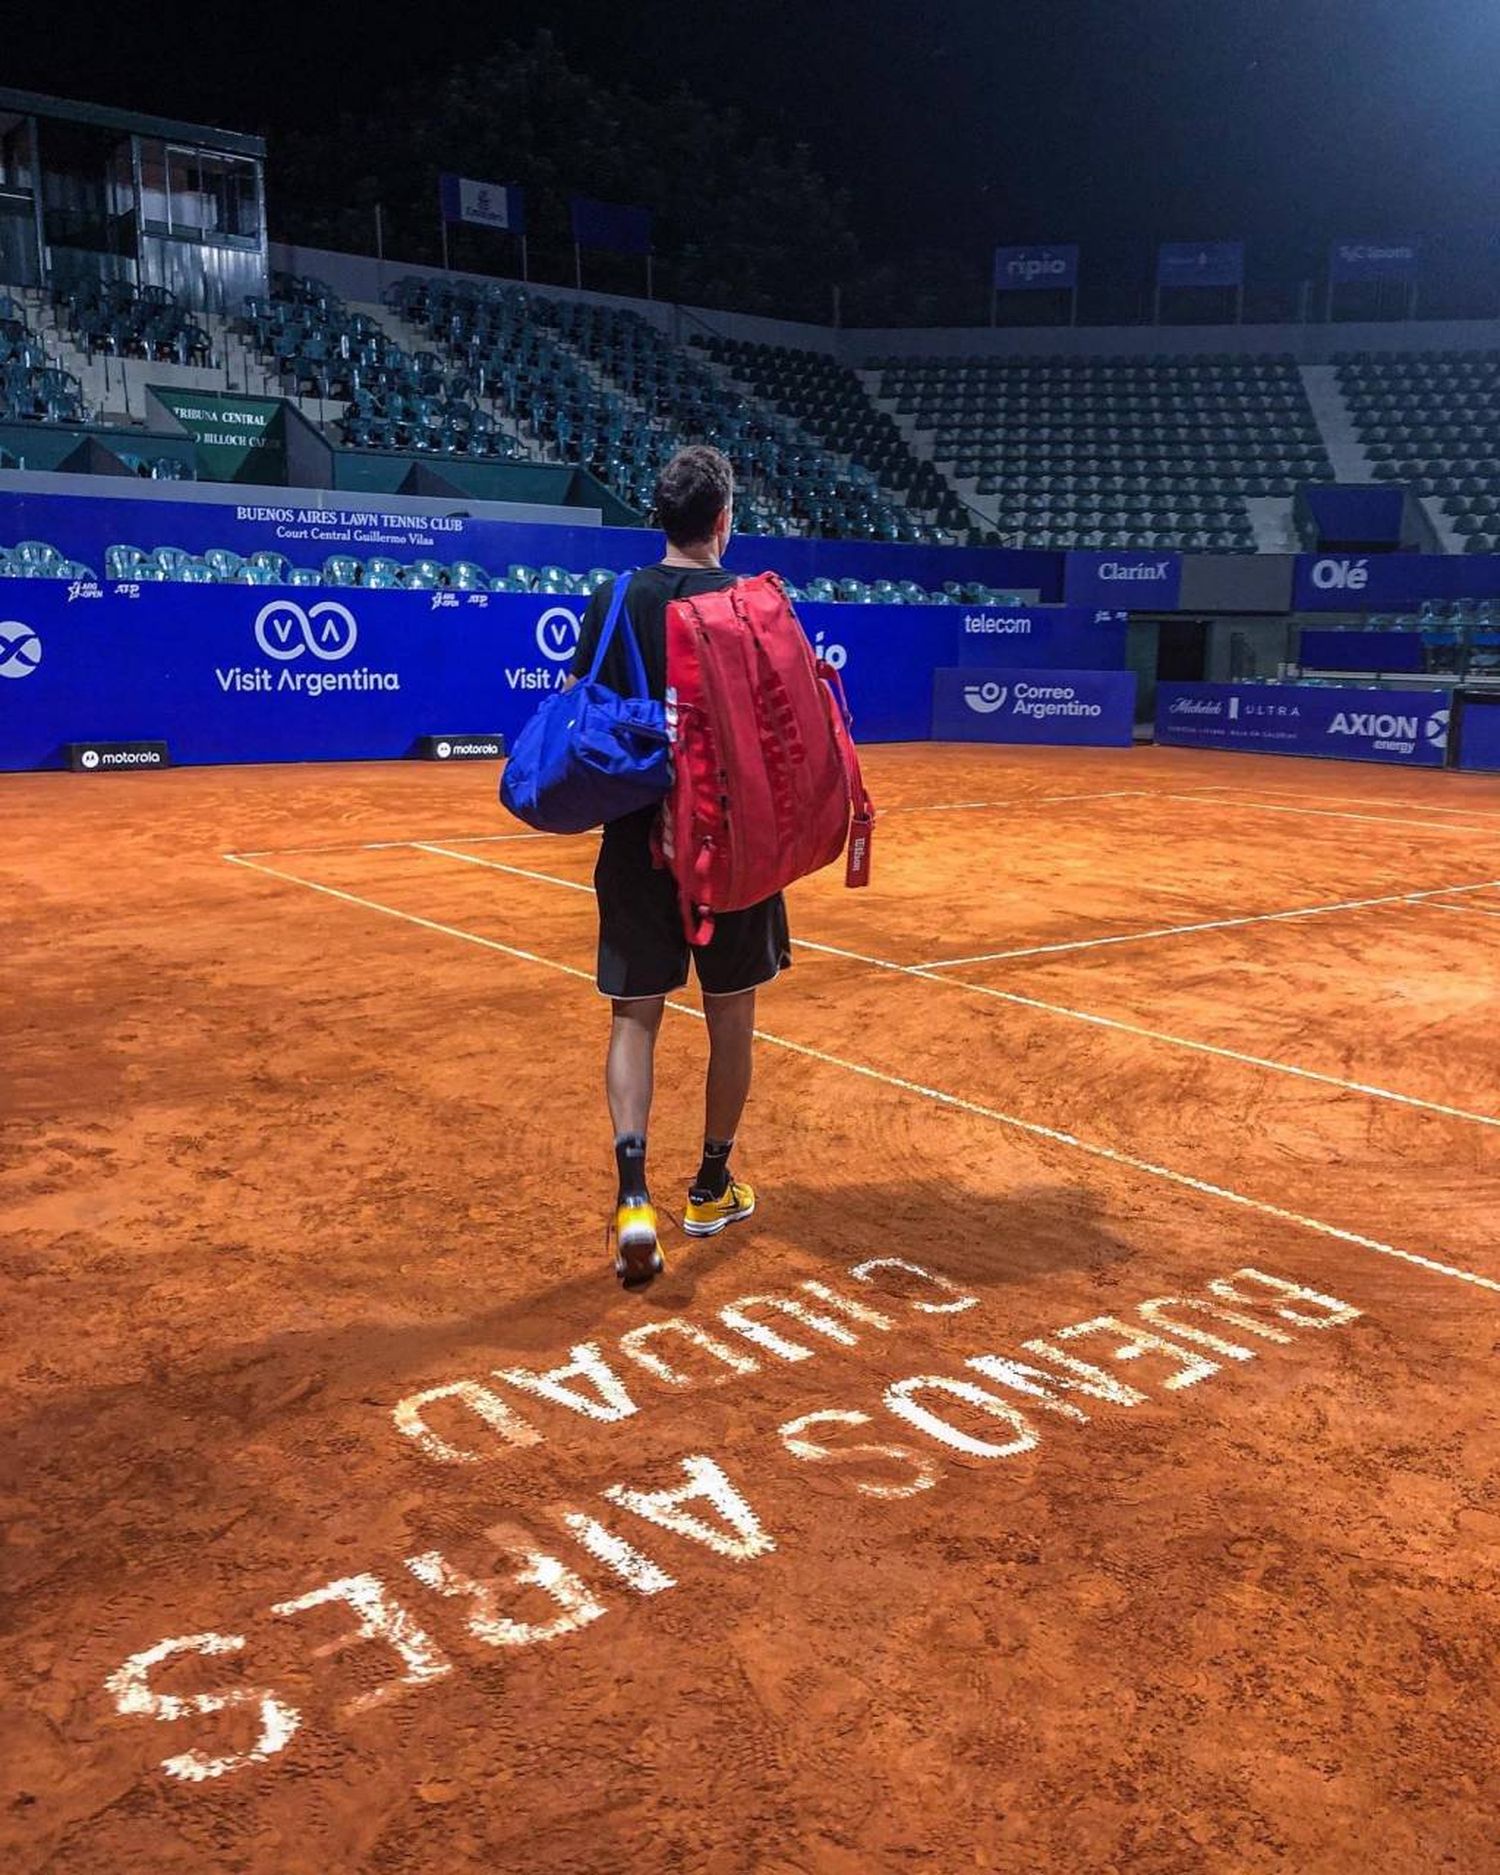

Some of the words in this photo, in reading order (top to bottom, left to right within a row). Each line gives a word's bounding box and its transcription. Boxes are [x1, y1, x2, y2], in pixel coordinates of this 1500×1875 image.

[1007, 253, 1066, 281] ripio
[173, 407, 218, 421] TRIBUNA
[222, 412, 267, 426] CENTRAL
[237, 506, 294, 522] BUENOS
[297, 510, 338, 525] AIRES
[341, 512, 378, 527] LAWN
[380, 515, 428, 530] TENNIS
[430, 518, 463, 531] CLUB
[276, 526, 308, 539] Court
[311, 528, 351, 541] Central
[353, 530, 406, 544] Guillermo
[408, 533, 434, 545] Vilas
[1313, 559, 1369, 589] Olé
[965, 613, 1031, 633] telecom
[215, 667, 272, 691] Visit
[277, 667, 400, 696] Argentina
[505, 668, 551, 689] Visit
[1014, 683, 1075, 699] Correo
[1012, 700, 1101, 718] Argentino
[1245, 705, 1300, 716] ULTRA
[1327, 713, 1418, 739] AXION
[452, 742, 499, 755] motorola
[1373, 740, 1415, 754] energy
[102, 751, 160, 765] motorola
[393, 1257, 980, 1462] CIUDAD
[777, 1268, 1364, 1499] BUENOS
[104, 1455, 777, 1781] AIRES
